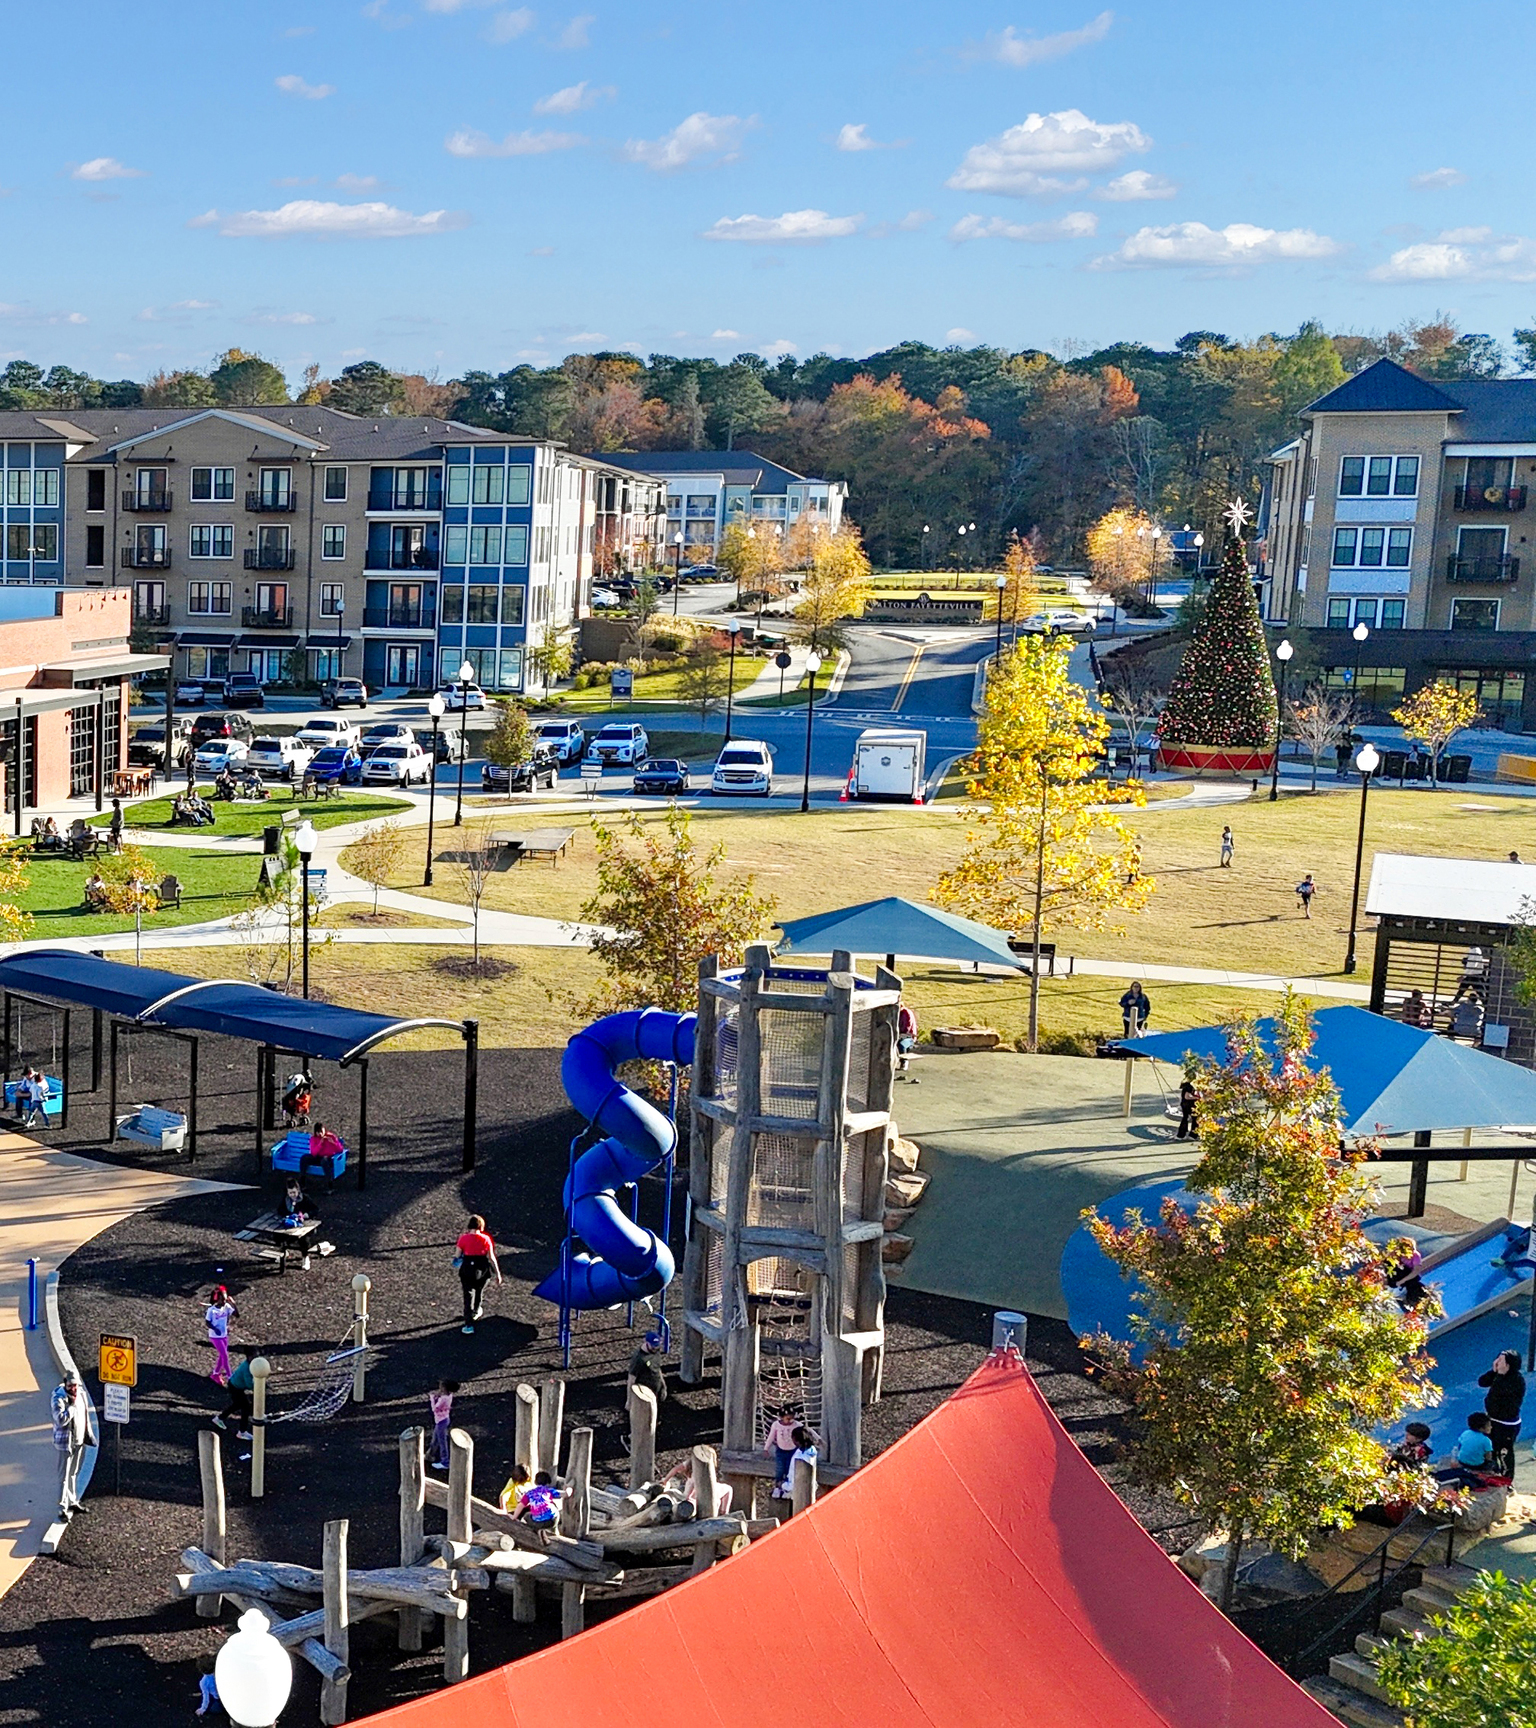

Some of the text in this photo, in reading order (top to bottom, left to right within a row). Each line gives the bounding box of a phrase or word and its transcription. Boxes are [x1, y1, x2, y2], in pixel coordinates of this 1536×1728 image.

[910, 602, 975, 610] FAYETTEVILLE
[102, 1337, 133, 1348] CAUTION
[103, 1371, 132, 1382] DO NOT RUN
